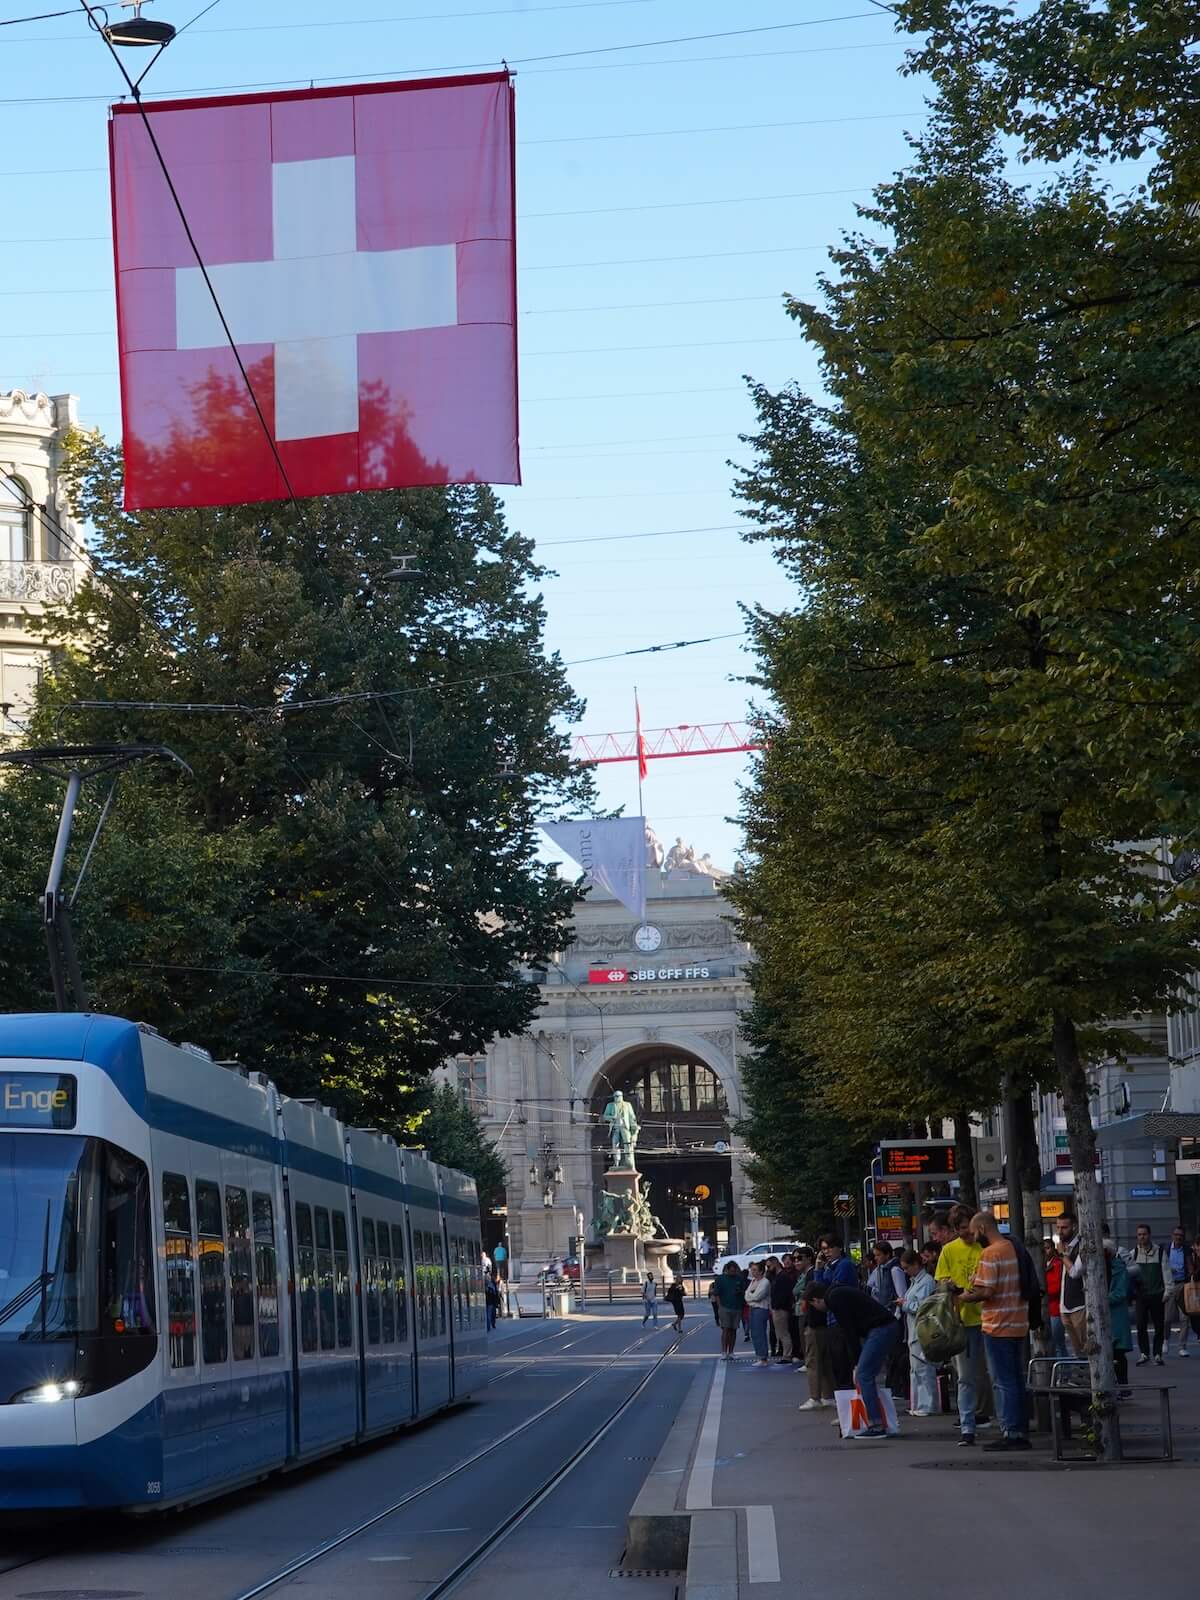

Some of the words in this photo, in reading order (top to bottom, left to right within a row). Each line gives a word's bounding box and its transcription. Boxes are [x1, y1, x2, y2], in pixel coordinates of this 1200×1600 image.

[629, 970, 656, 981] SBB
[658, 969, 682, 979] CFF
[685, 968, 709, 978] FFS
[4, 1083, 68, 1112] Enge
